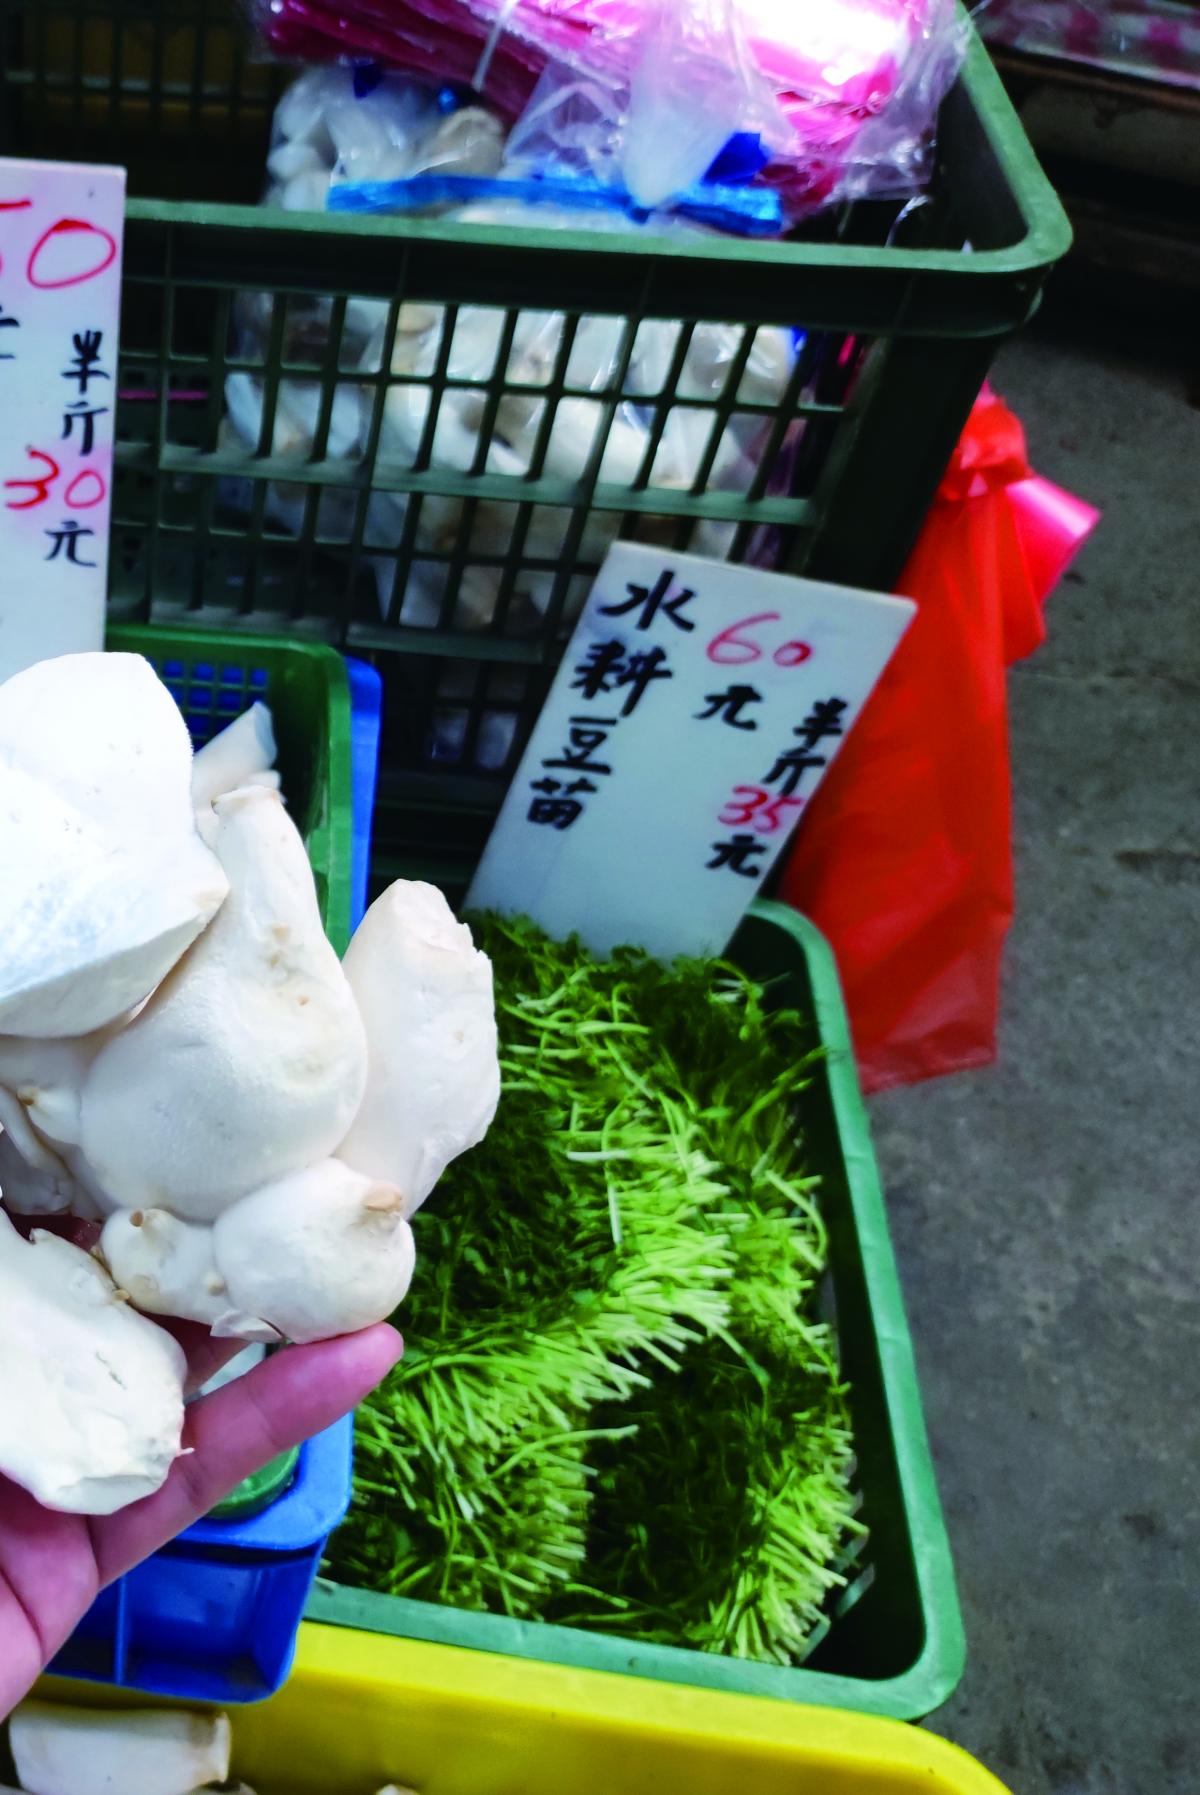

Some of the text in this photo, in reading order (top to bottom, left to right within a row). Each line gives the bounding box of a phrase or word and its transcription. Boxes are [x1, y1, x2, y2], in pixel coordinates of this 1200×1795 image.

[60, 329, 111, 456] 半斤
[3, 445, 106, 510] 30
[44, 519, 98, 568] 元
[705, 611, 815, 668] 60
[524, 568, 698, 832] 水耕豆苗
[693, 683, 766, 732] 元
[760, 697, 847, 797] 半斤
[716, 784, 804, 835] 35
[704, 833, 768, 879] 元
